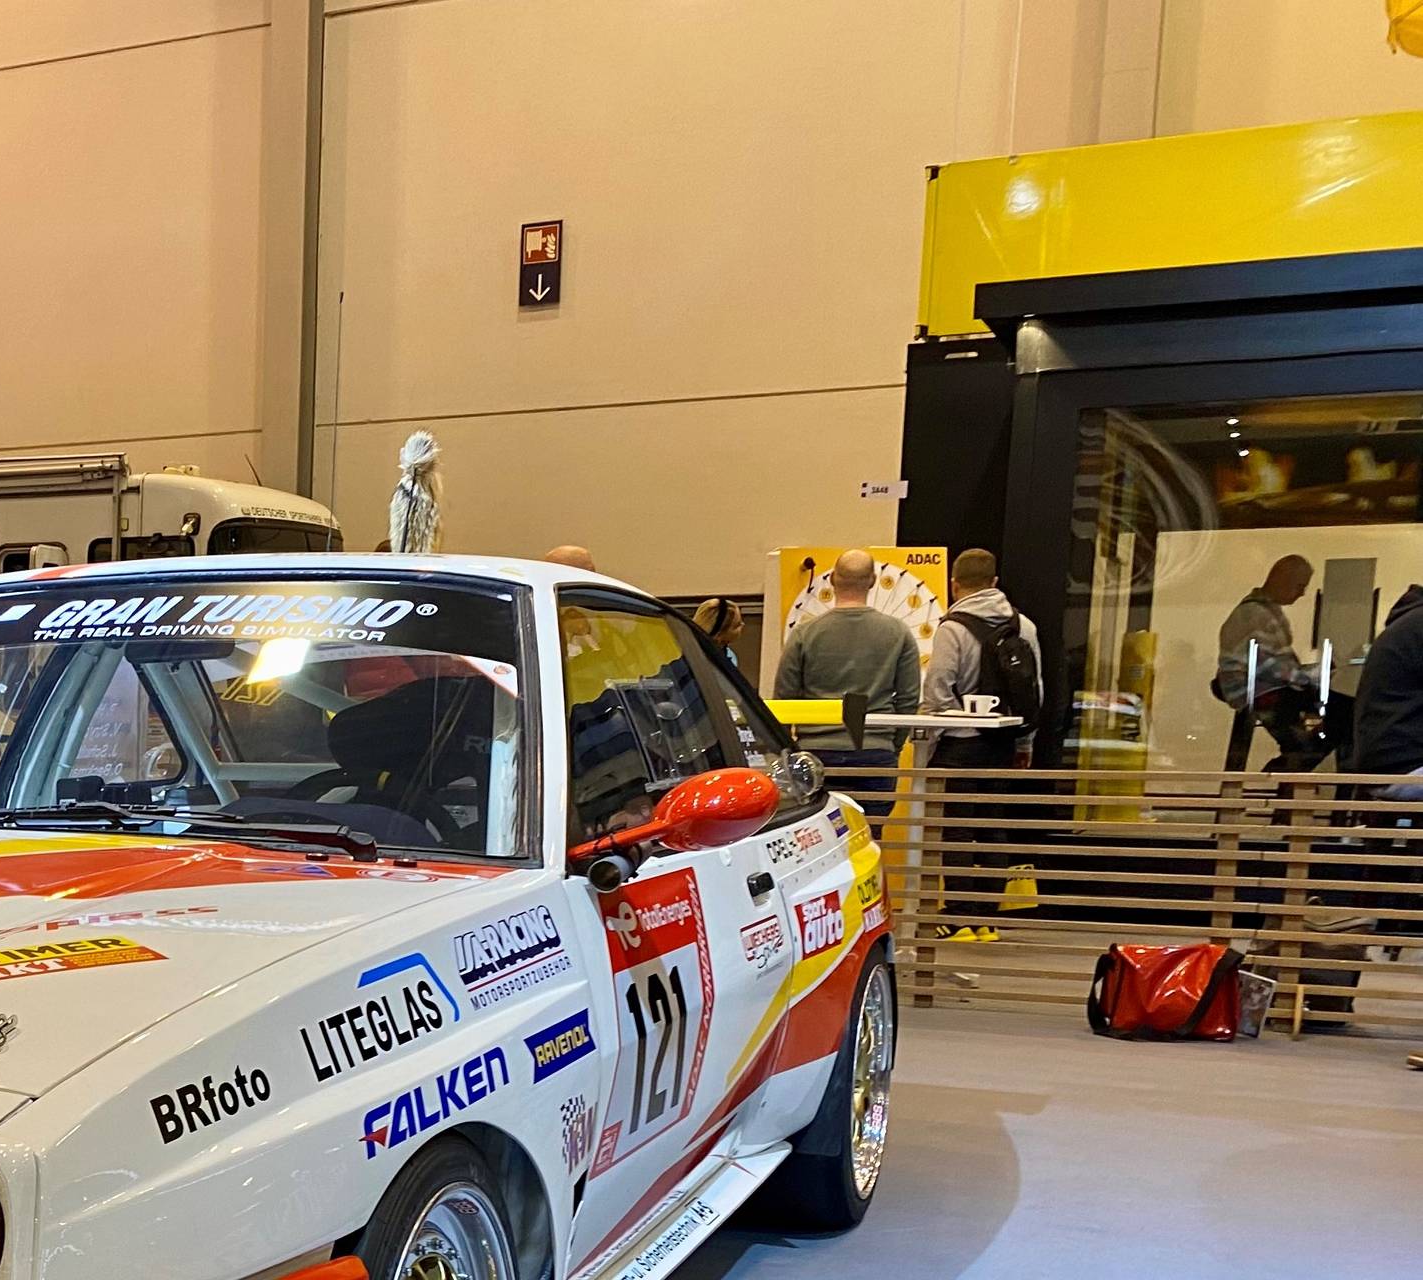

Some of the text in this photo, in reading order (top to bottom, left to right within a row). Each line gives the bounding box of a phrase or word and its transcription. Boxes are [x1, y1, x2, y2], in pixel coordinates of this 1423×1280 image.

[906, 553, 941, 565] ADAC
[33, 624, 386, 643] THE REAL DRIVING SIMULATOR
[39, 596, 184, 629] GRAN
[803, 908, 844, 954] auto
[299, 980, 443, 1083] LITEGLAS
[535, 1025, 592, 1070] RAVENOL
[625, 965, 688, 1136] 121
[149, 1064, 271, 1145] BRfoto
[359, 1046, 511, 1161] FALKEN
